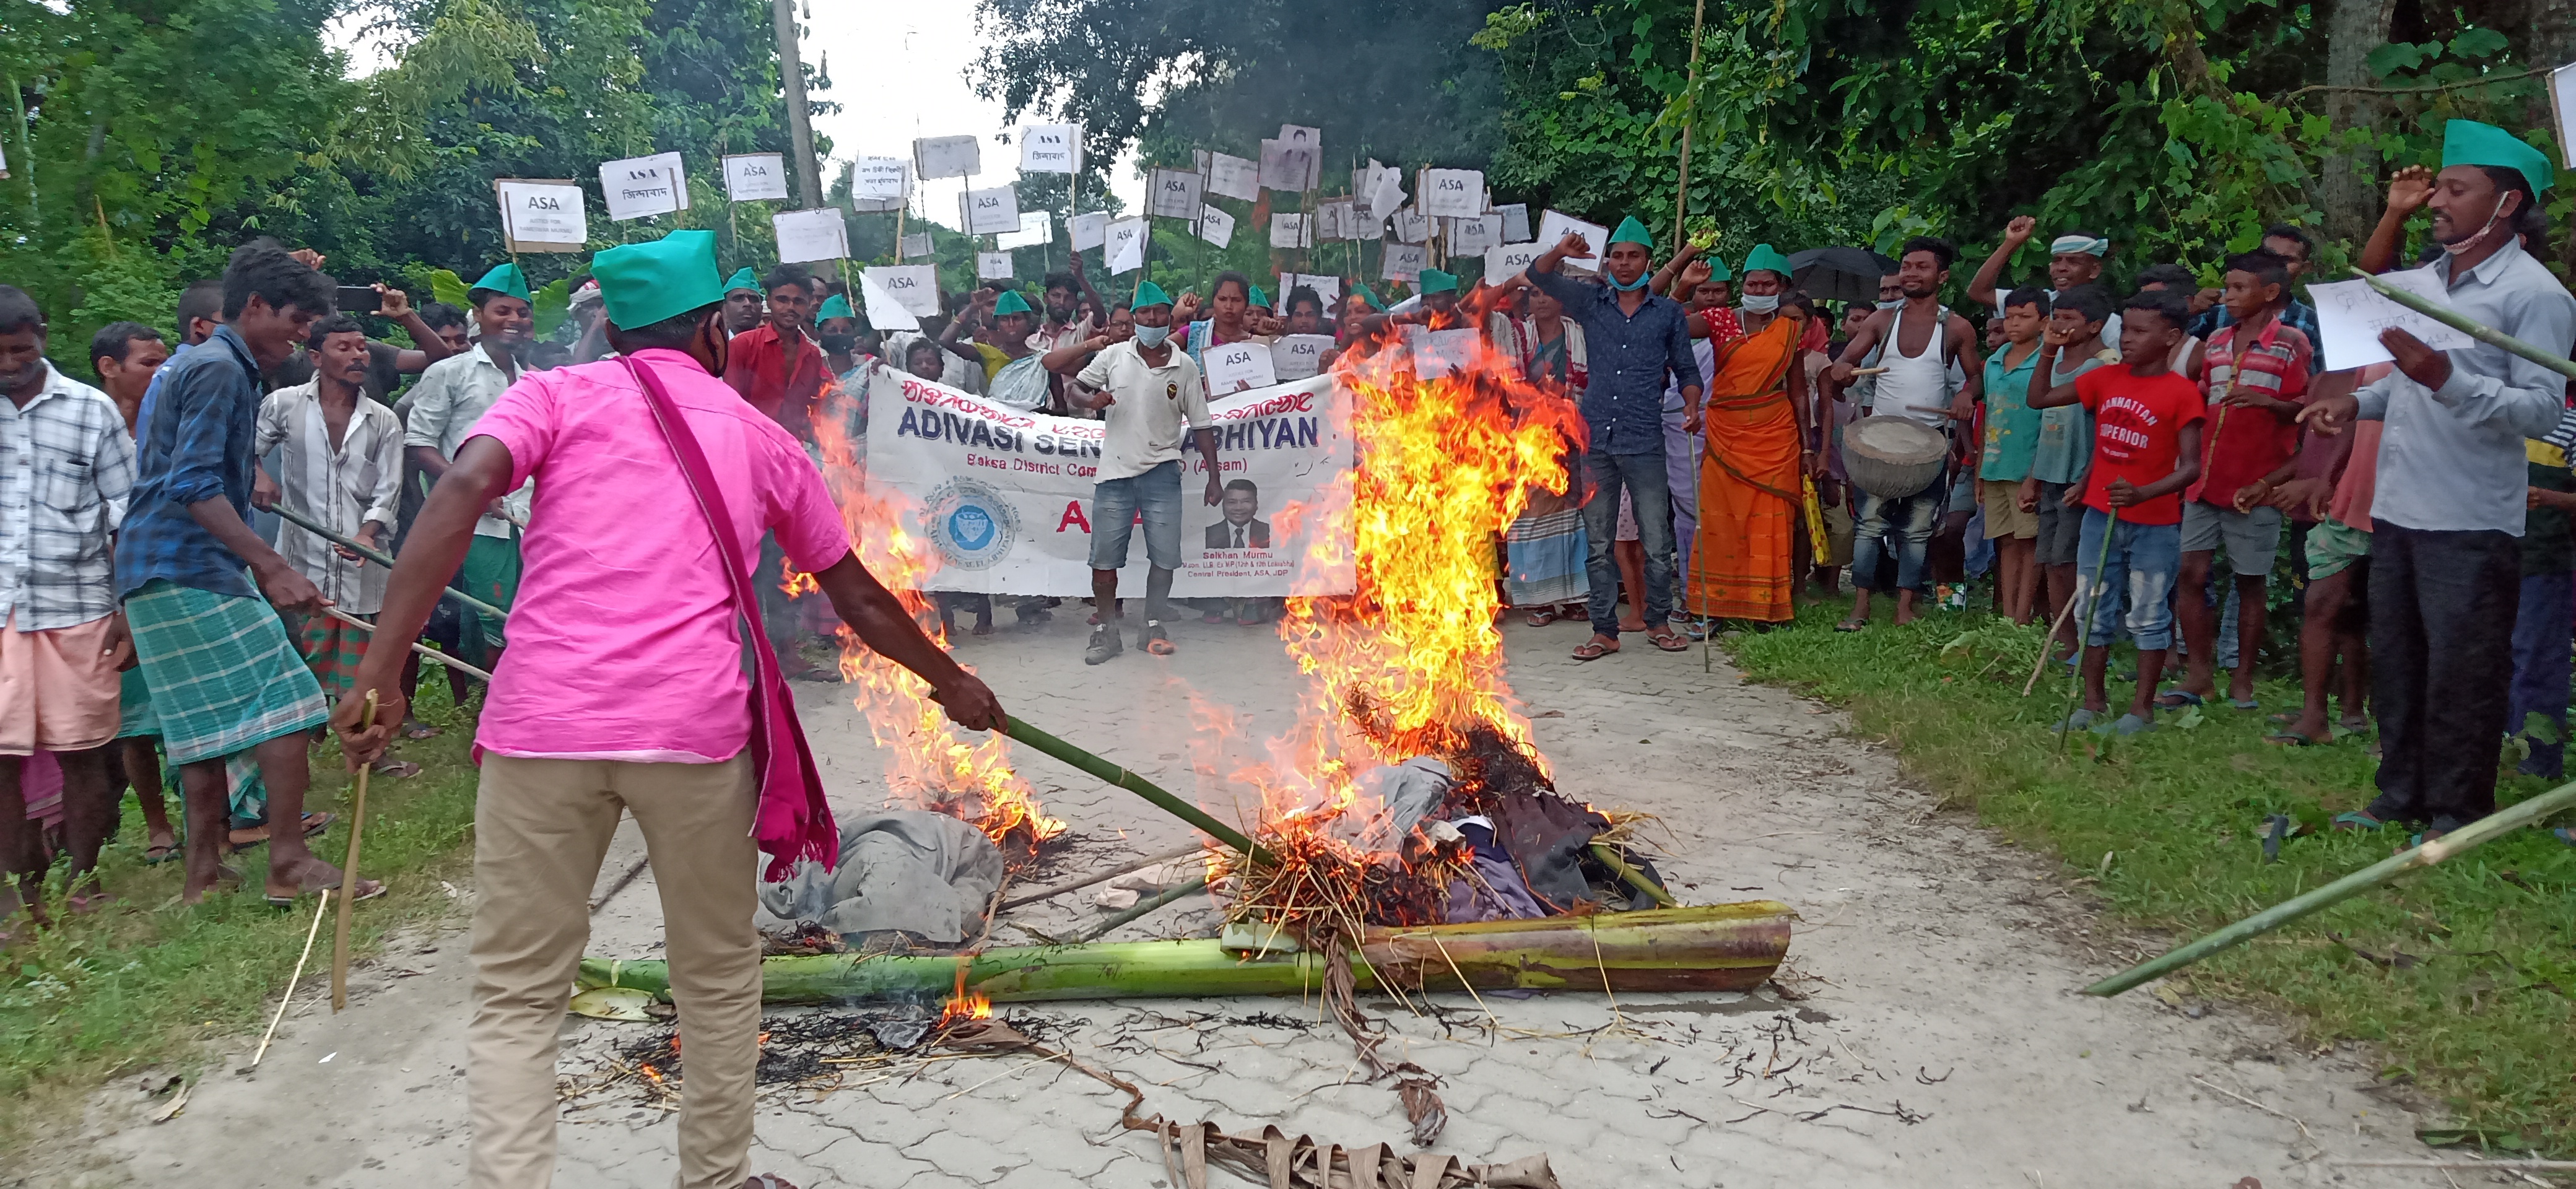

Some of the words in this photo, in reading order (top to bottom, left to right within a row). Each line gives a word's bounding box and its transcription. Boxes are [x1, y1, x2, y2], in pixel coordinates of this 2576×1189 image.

[625, 168, 660, 181] ASA
[744, 166, 767, 176] ASA
[1165, 180, 1186, 193] ASA
[1438, 179, 1463, 191] ASA
[528, 196, 560, 211] ASA
[978, 198, 999, 209] ASA
[1205, 214, 1221, 225] ASA
[1284, 222, 1299, 230] ASA
[1117, 229, 1133, 241] ASA
[1399, 253, 1419, 263] ASA
[1505, 253, 1531, 266] ASA
[887, 277, 915, 290] ASA
[1291, 344, 1315, 355] ASA
[1225, 351, 1251, 366] ASA
[898, 406, 1025, 454] ADIVASI
[967, 453, 1007, 469] Baksa
[1014, 458, 1060, 476] District
[1193, 458, 1247, 476] (Asam)
[1203, 551, 1238, 559] Salkhan
[1243, 551, 1273, 559] Murmu
